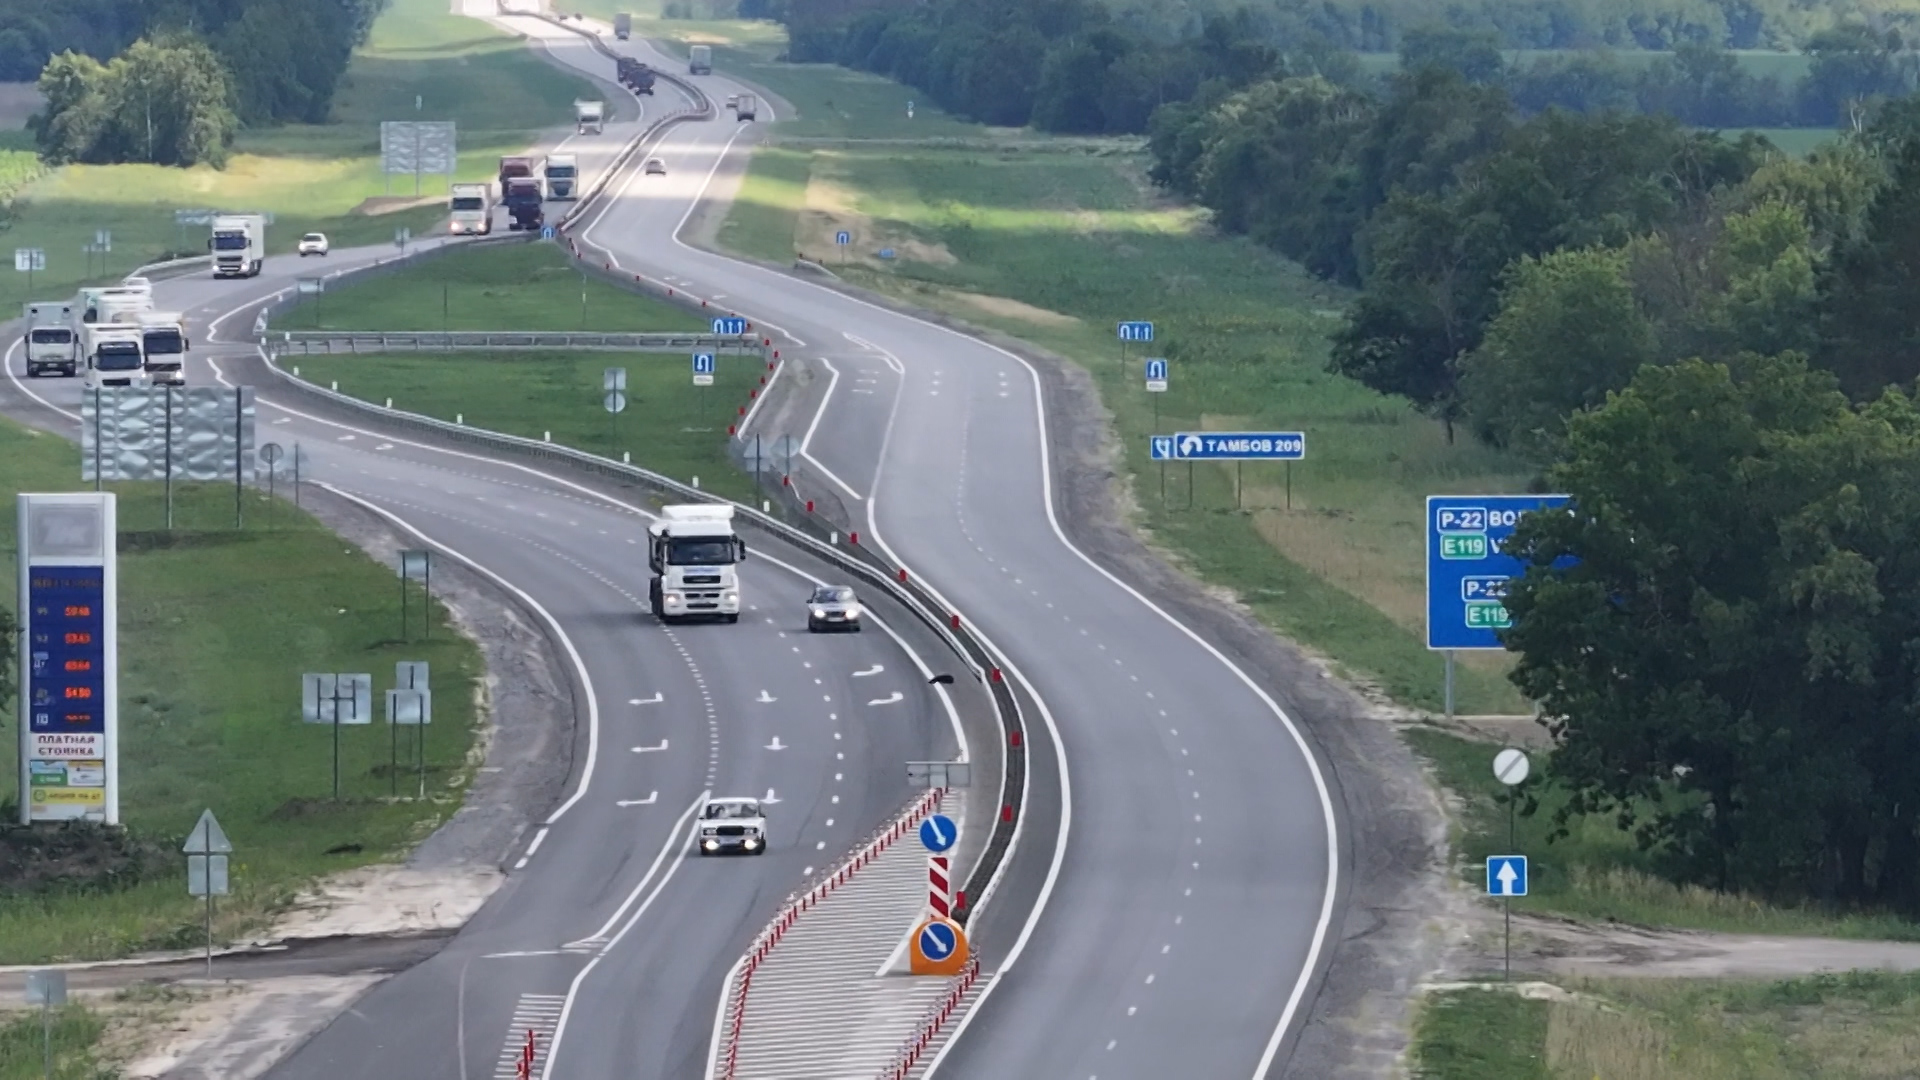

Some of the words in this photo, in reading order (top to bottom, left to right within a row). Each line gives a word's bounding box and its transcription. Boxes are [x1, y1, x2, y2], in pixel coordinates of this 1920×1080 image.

[1206, 439, 1272, 452] ТАМБОВ
[1275, 439, 1301, 452] 209
[1444, 538, 1484, 554] E119
[38, 735, 95, 744] ПЛАТНАЯ
[38, 747, 95, 756] СТОЯНКА
